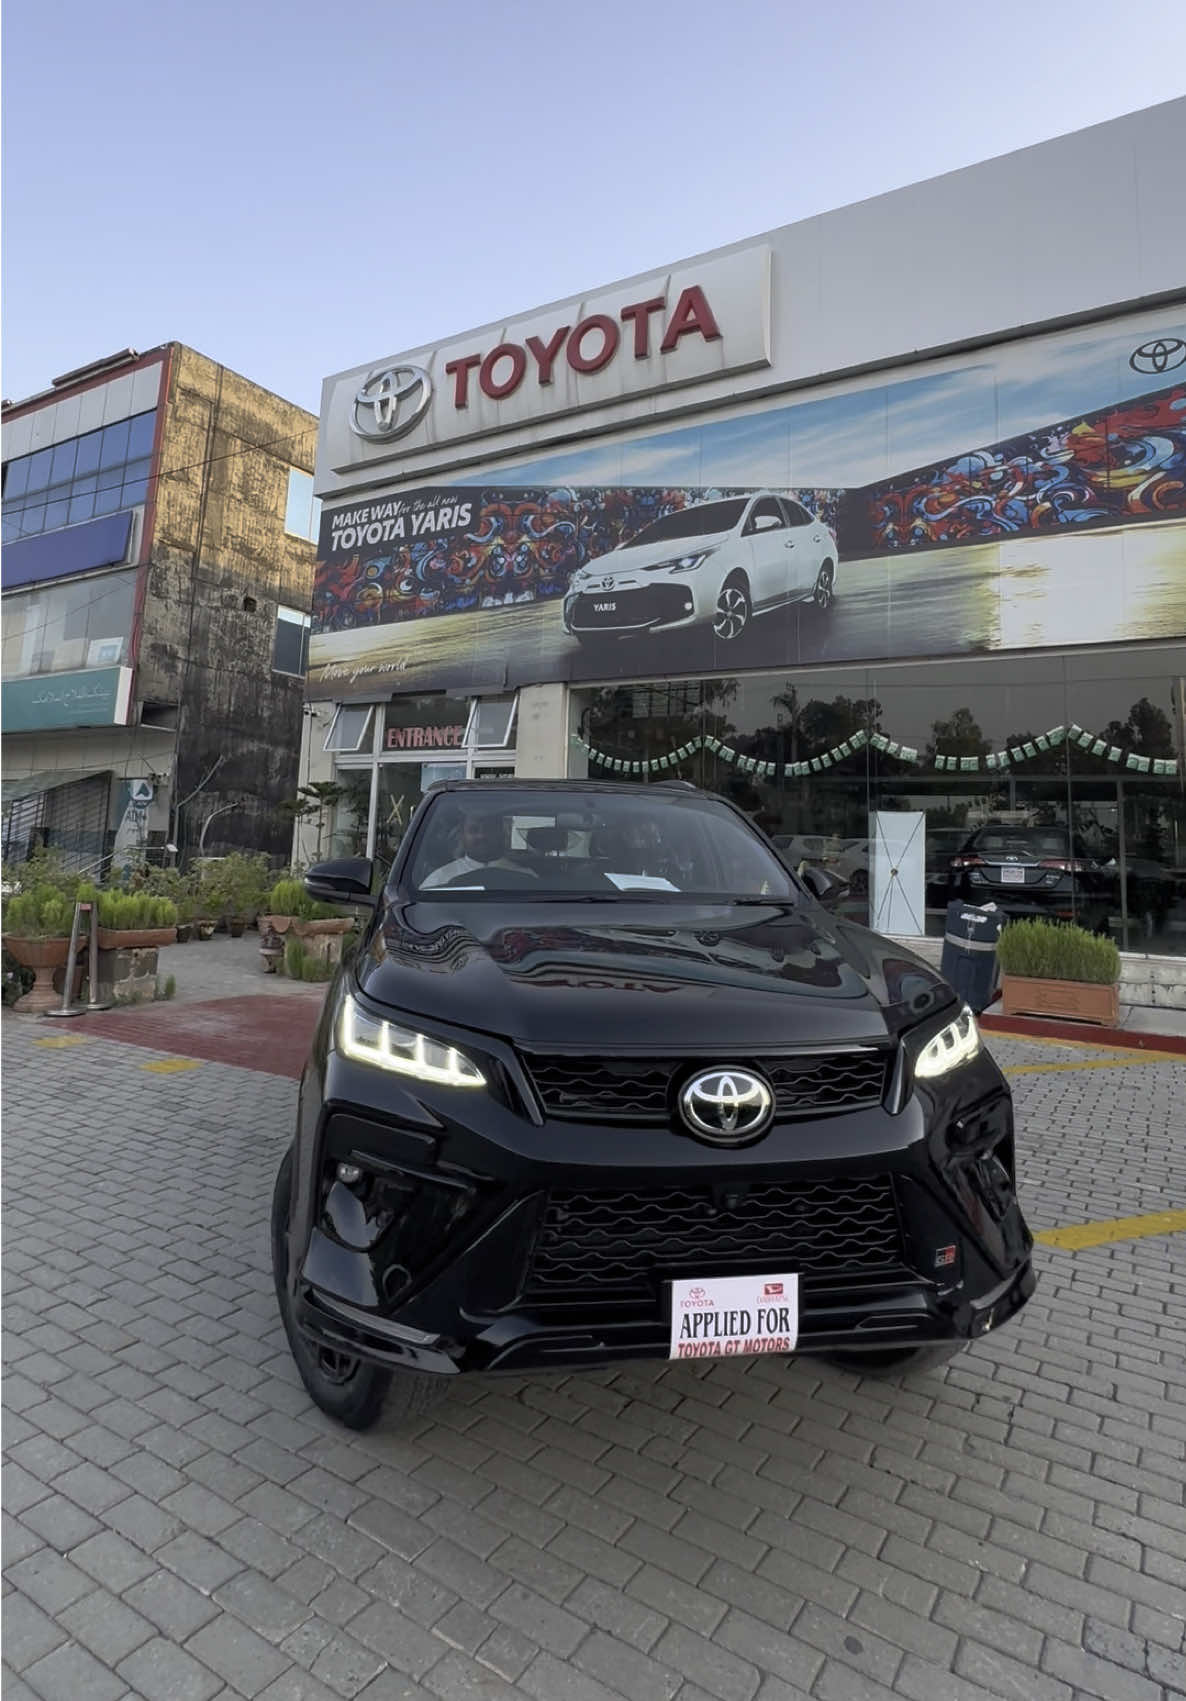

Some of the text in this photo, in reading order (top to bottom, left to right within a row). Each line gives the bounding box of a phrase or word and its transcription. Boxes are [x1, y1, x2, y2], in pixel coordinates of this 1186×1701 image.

[445, 285, 723, 409] TOYOTA
[331, 508, 369, 529] MAKE
[370, 501, 401, 521] WAY
[331, 503, 472, 551] TOYOTA YARIS
[593, 602, 617, 612] YARIS
[387, 725, 463, 748] ENTRANCE
[680, 1299, 715, 1309] TOYOTA
[680, 1307, 790, 1339] APPLIED FOR
[678, 1336, 791, 1358] TOYOTA GT MOTORS
